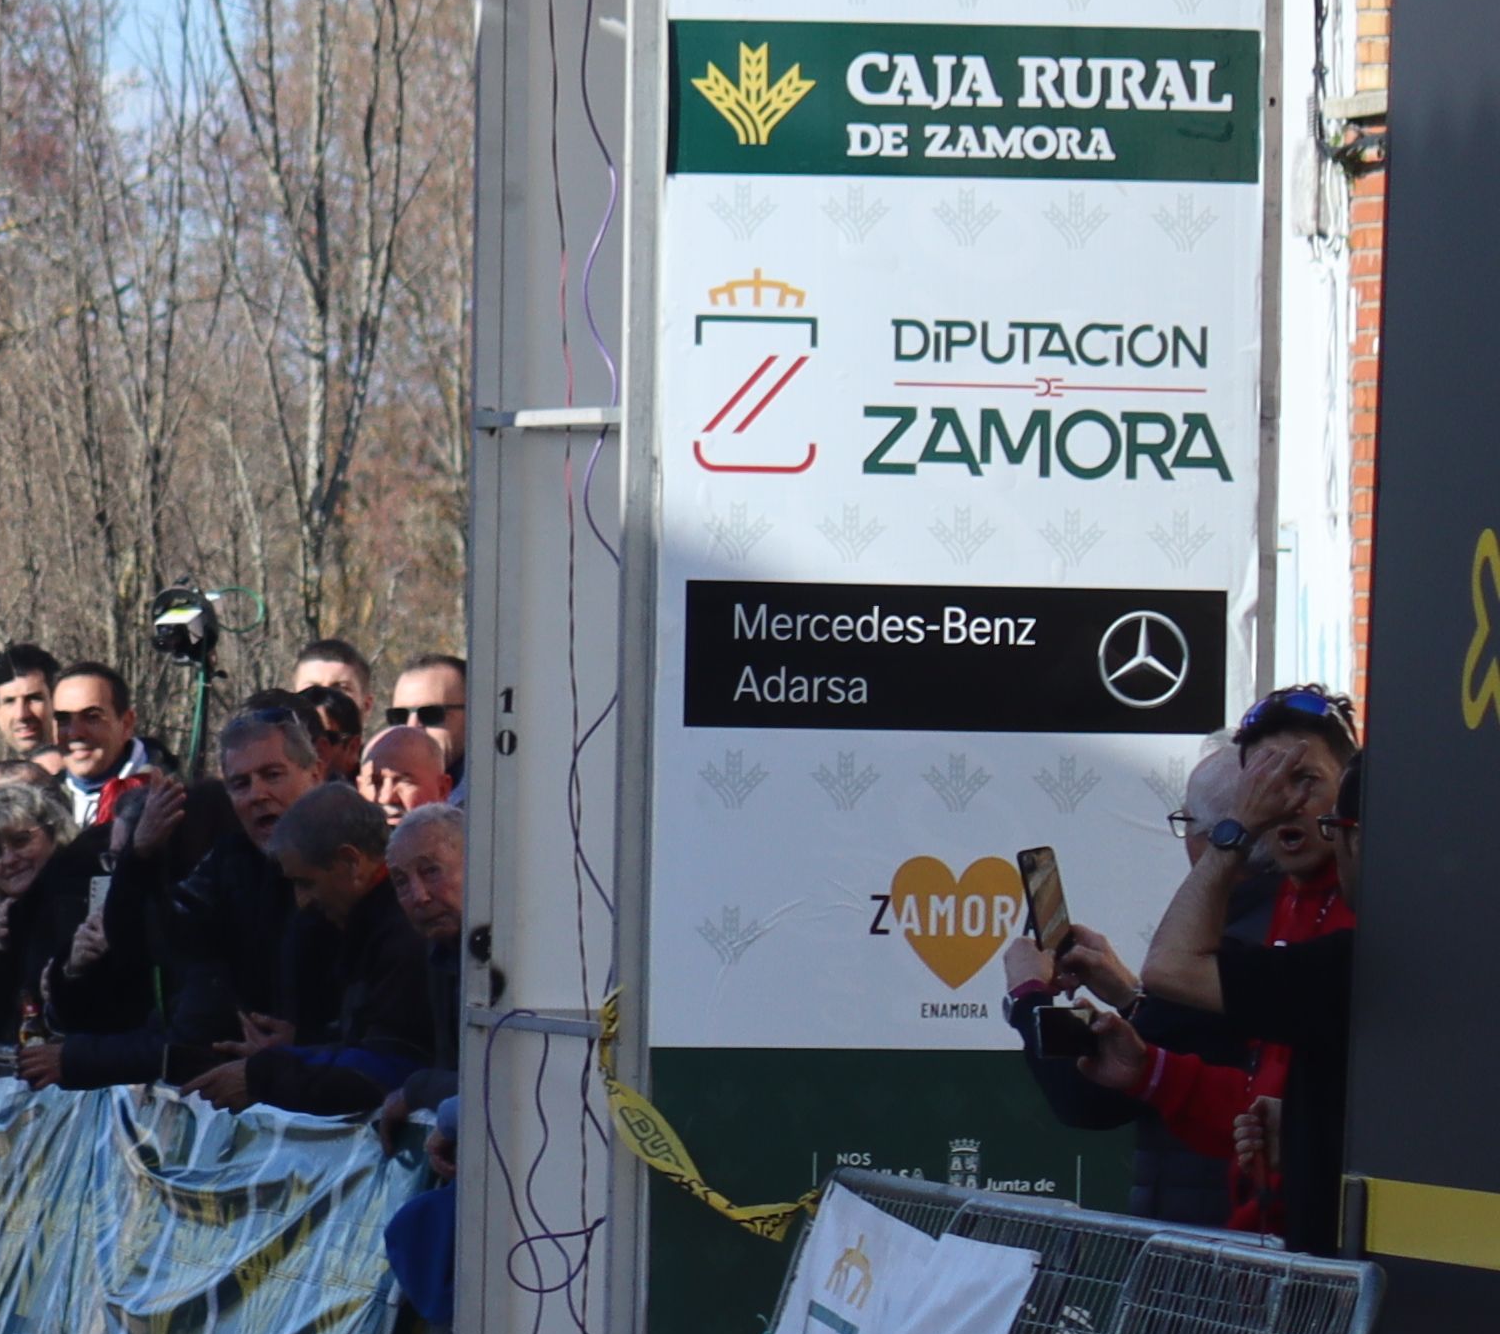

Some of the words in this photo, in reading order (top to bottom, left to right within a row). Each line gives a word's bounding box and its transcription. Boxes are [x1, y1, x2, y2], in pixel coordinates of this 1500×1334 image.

[847, 52, 1003, 109] CAJA
[1018, 57, 1232, 111] RURAL
[847, 124, 908, 156] DE
[924, 125, 1115, 160] ZAMORA
[863, 406, 1233, 482] ZAMORA
[735, 604, 1036, 645] Mercedes-Benz
[734, 666, 867, 703] Adarsa
[921, 1003, 988, 1018] ENAMORA
[836, 1153, 871, 1166] NOS
[983, 1177, 1030, 1193] Junta
[1033, 1178, 1056, 1193] de
